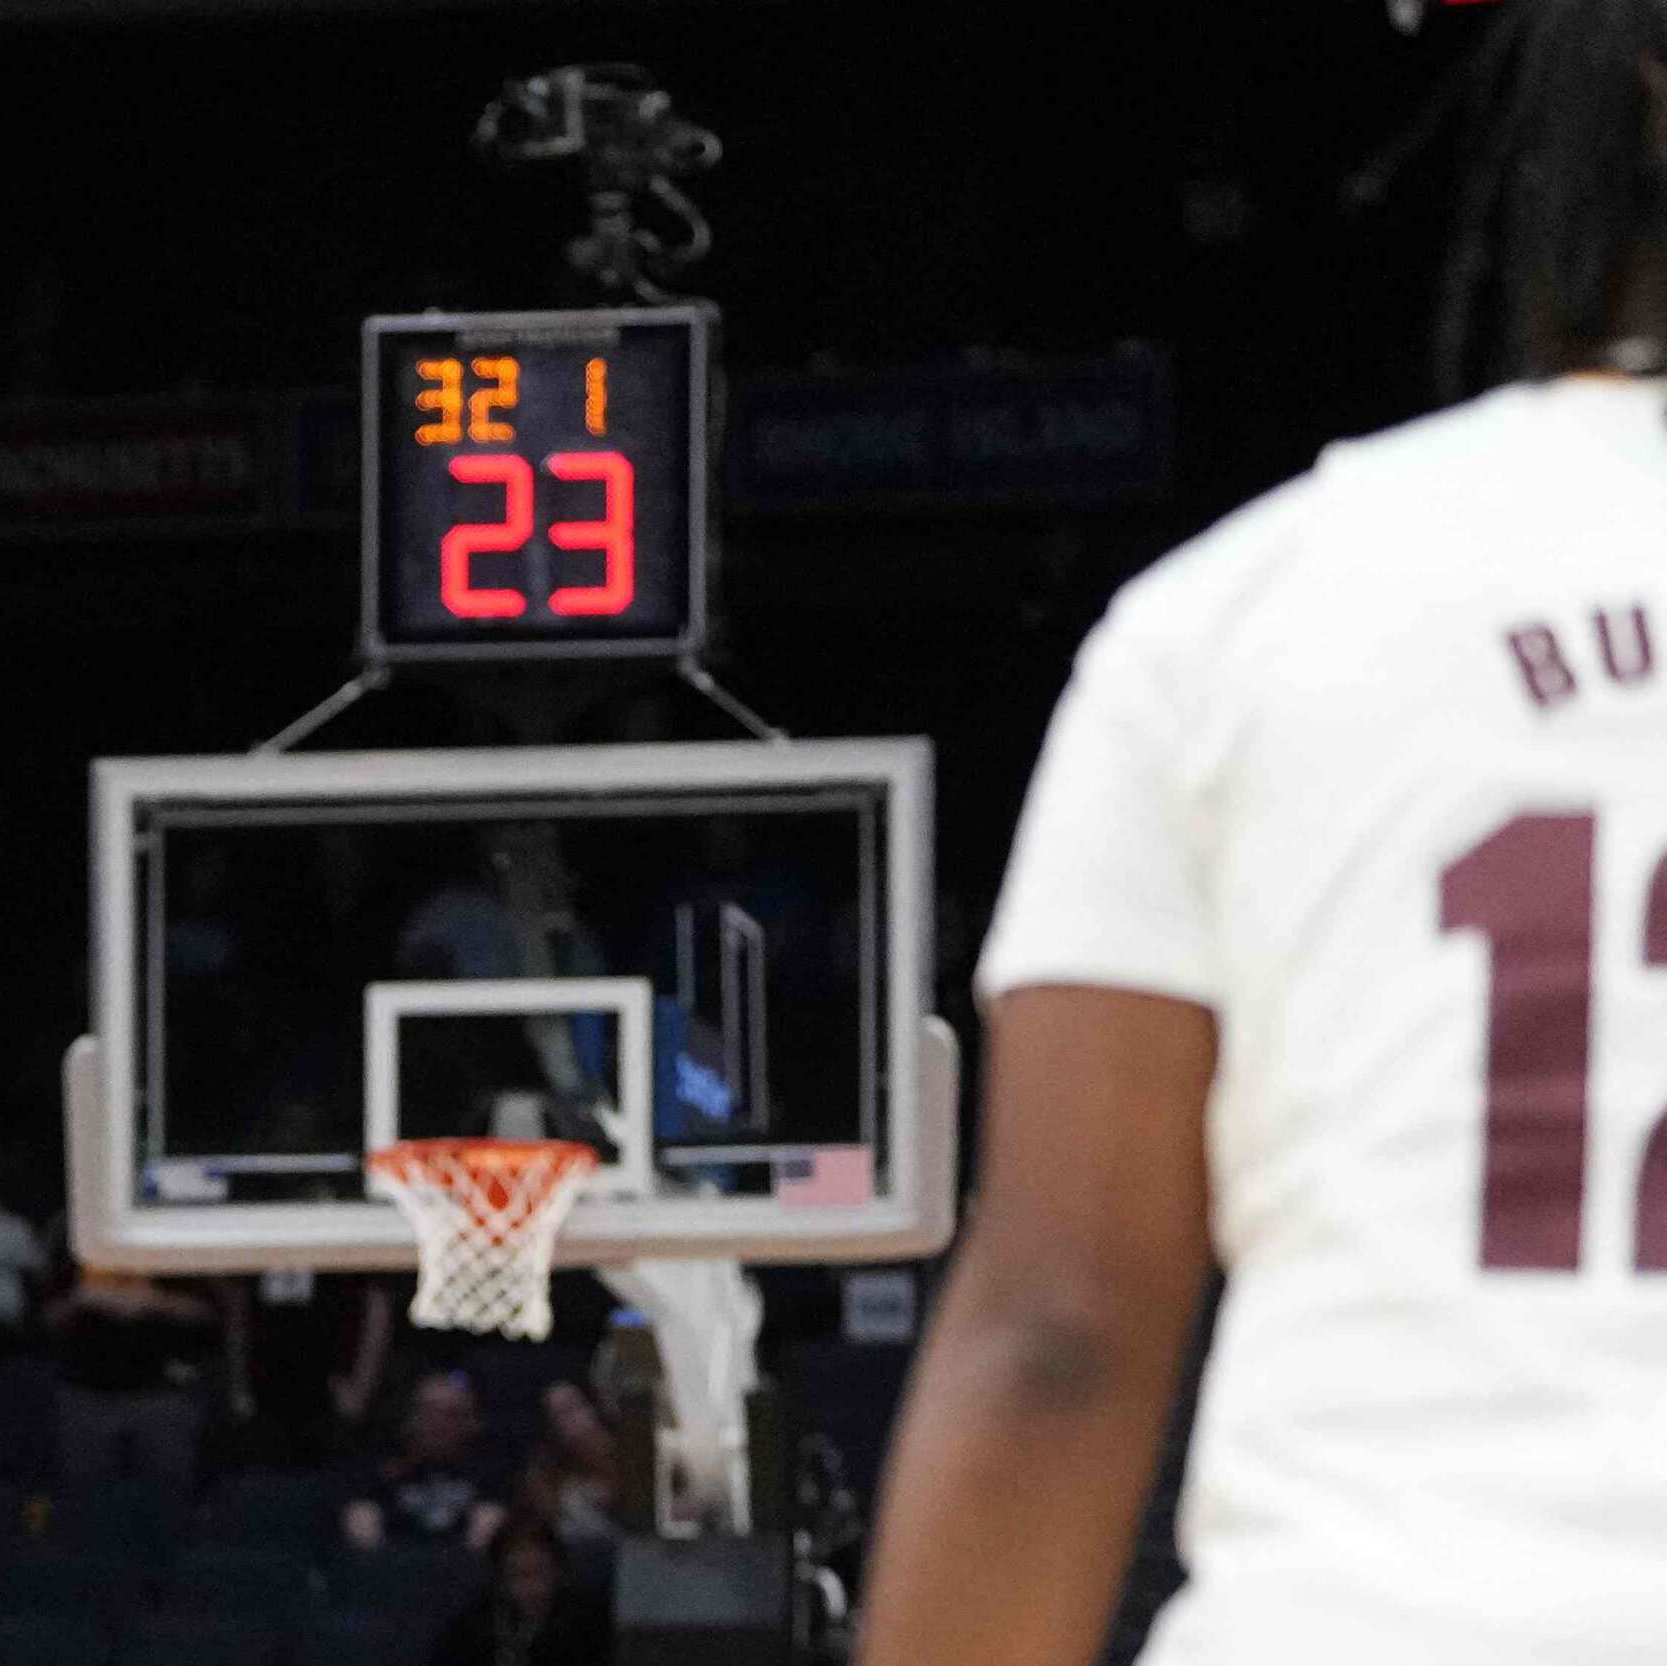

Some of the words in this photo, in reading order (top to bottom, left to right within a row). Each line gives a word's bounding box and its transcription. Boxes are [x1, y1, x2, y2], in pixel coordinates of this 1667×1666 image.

[414, 356, 522, 446] 32
[584, 356, 609, 436] 1
[440, 450, 636, 619] 23
